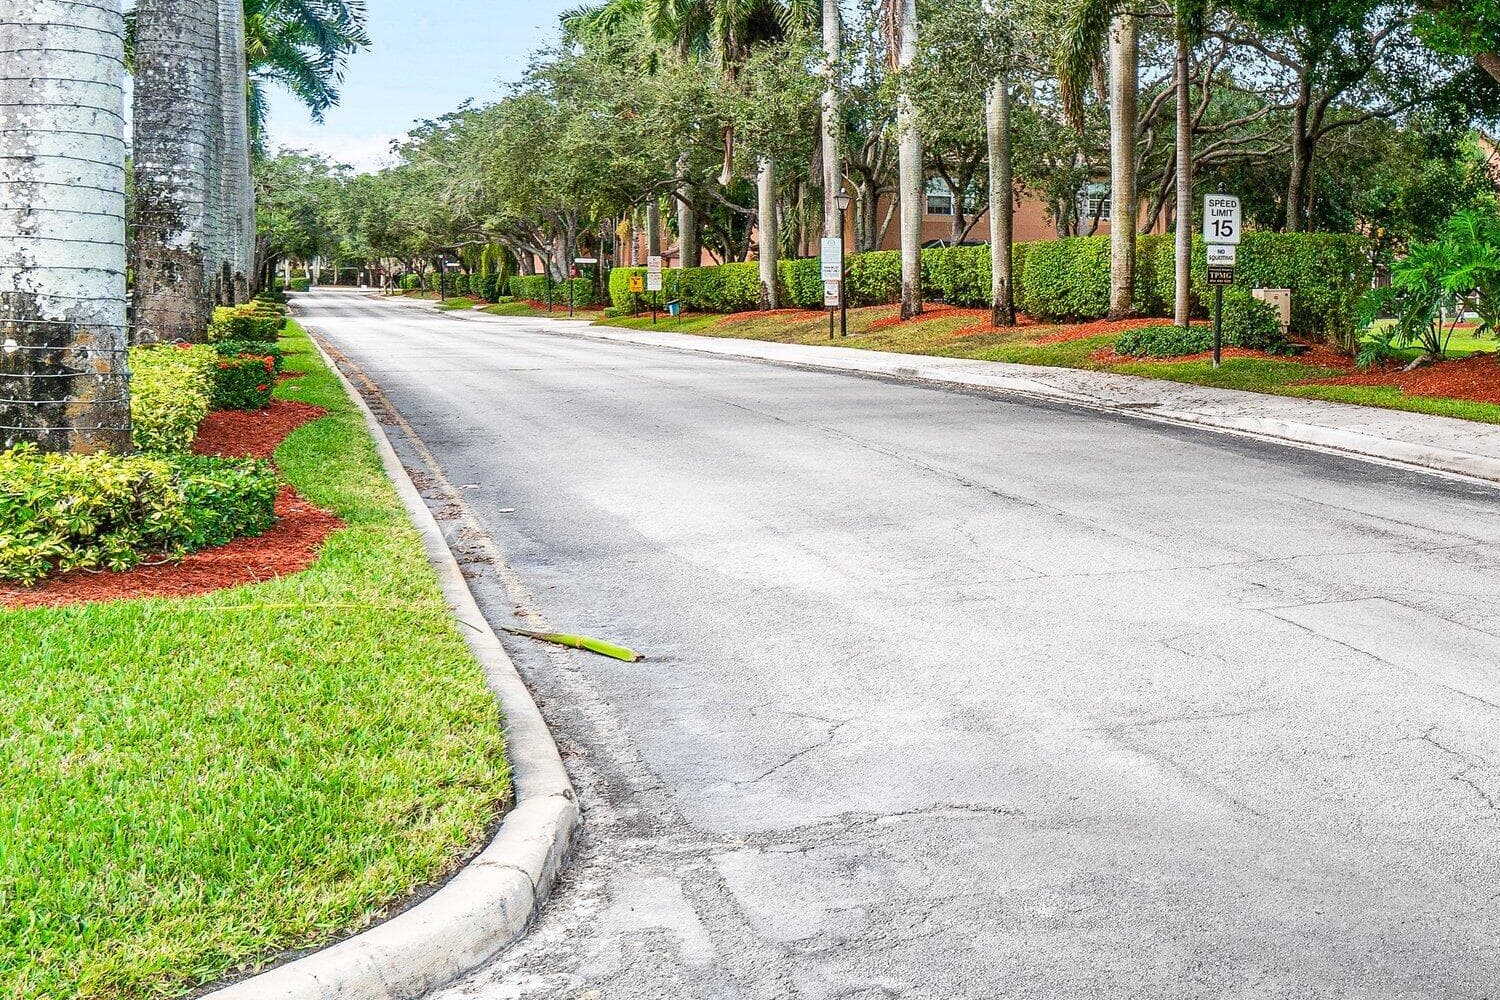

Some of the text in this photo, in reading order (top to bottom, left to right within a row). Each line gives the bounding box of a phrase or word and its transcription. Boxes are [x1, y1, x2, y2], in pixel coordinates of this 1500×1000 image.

[1209, 199, 1237, 208] SPEED
[1211, 209, 1234, 217] LIMIT
[1211, 219, 1233, 237] 15
